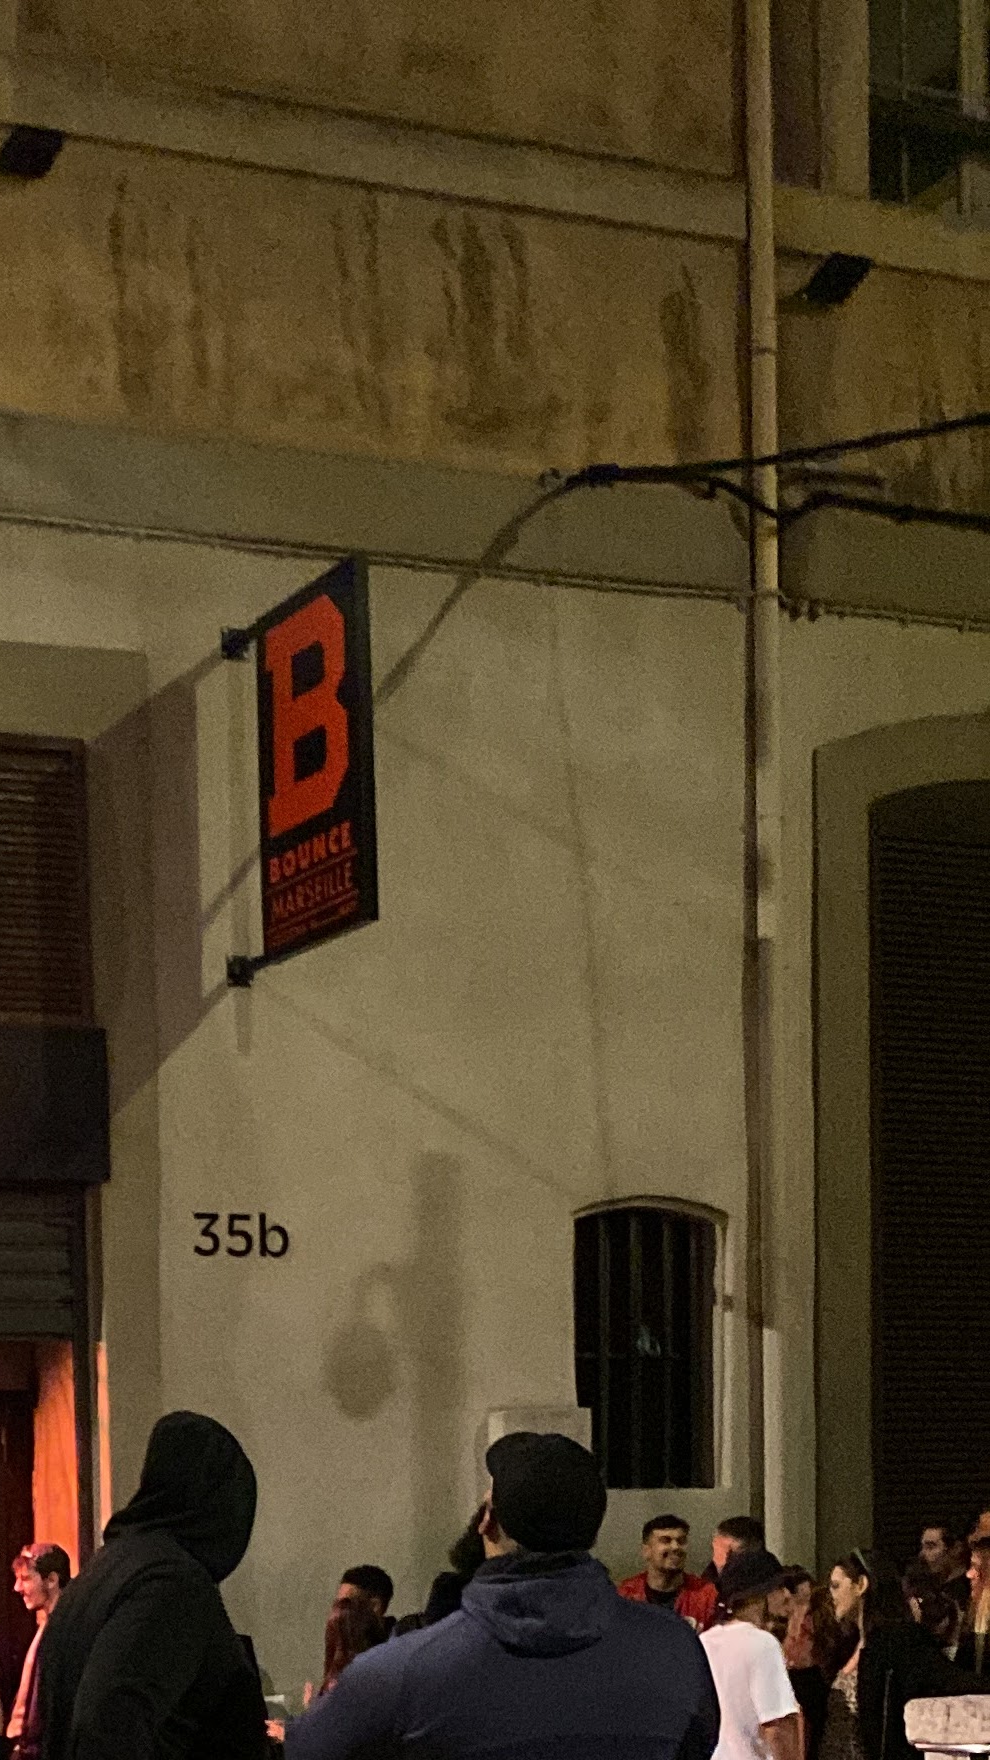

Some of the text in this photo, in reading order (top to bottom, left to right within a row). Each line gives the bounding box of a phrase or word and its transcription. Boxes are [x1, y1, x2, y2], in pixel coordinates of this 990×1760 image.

[266, 593, 349, 838] B
[269, 820, 351, 884] BOUNCE
[271, 861, 352, 919] MARSEILLE
[193, 1212, 289, 1258] 35b
